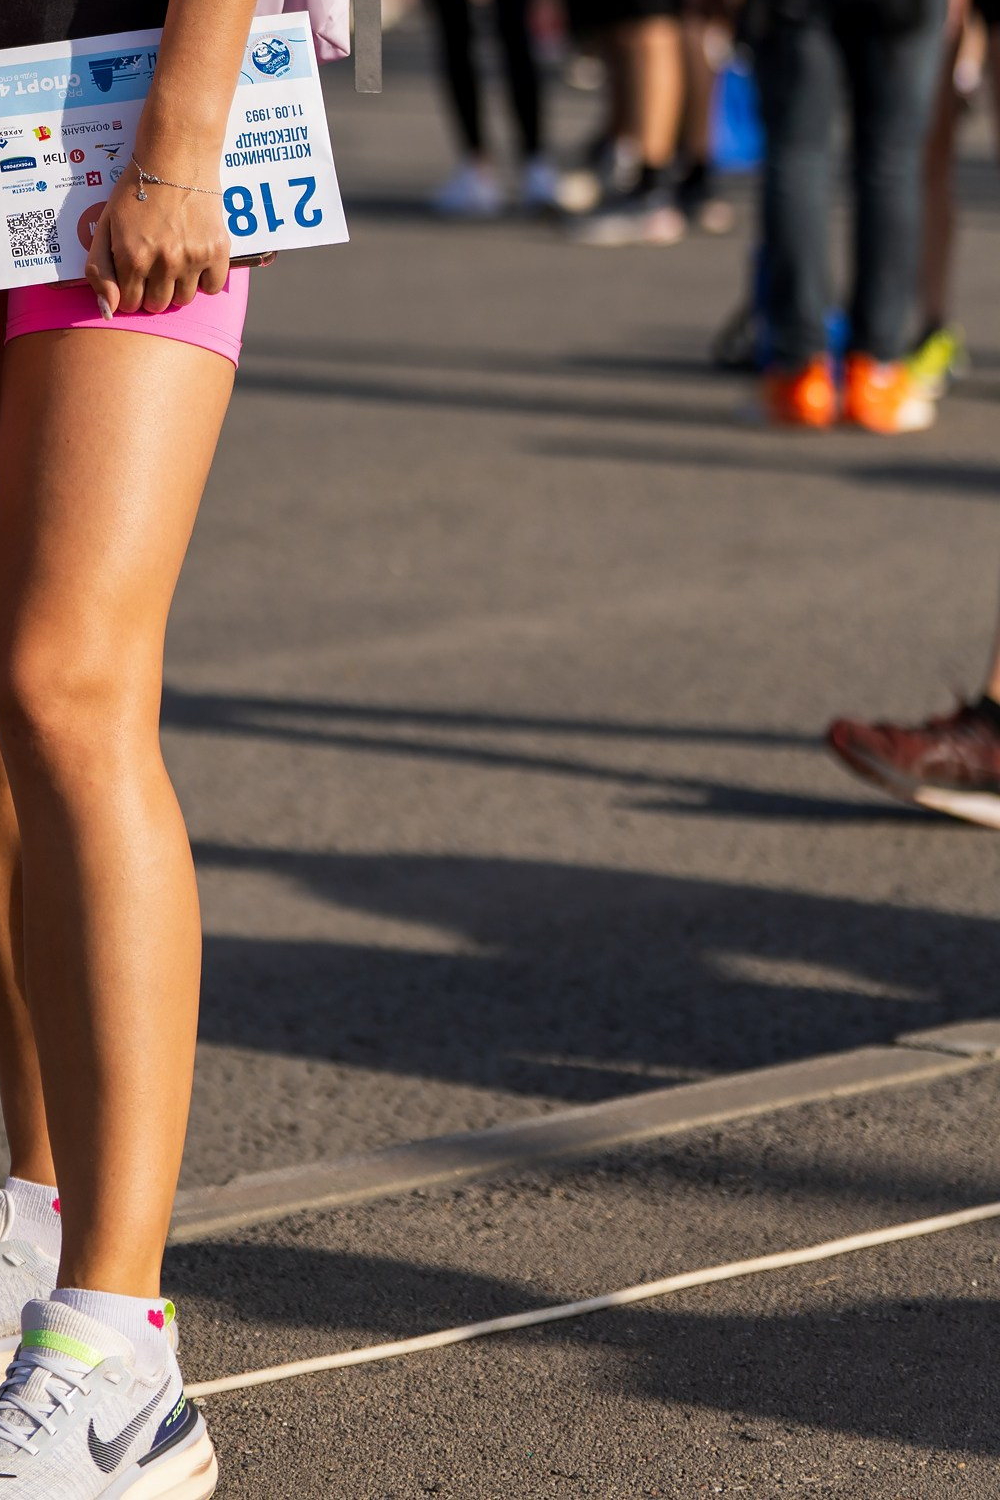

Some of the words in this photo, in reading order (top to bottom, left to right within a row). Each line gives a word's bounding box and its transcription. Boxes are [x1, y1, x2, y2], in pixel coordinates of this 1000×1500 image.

[15, 73, 81, 95] СПОРТ
[58, 87, 83, 99] PRO
[245, 103, 304, 123] 11.09.1993
[61, 123, 110, 136] ФОРАБАНК
[235, 125, 308, 149] АЛЕКСАНДР
[43, 152, 67, 166] Пэй
[224, 142, 312, 168] КОТЕЛЬНИКОВ
[11, 186, 35, 194] РОССЕТИ
[223, 176, 323, 237] 218
[13, 255, 62, 269] РЕЗУЛЬТАТЫ
